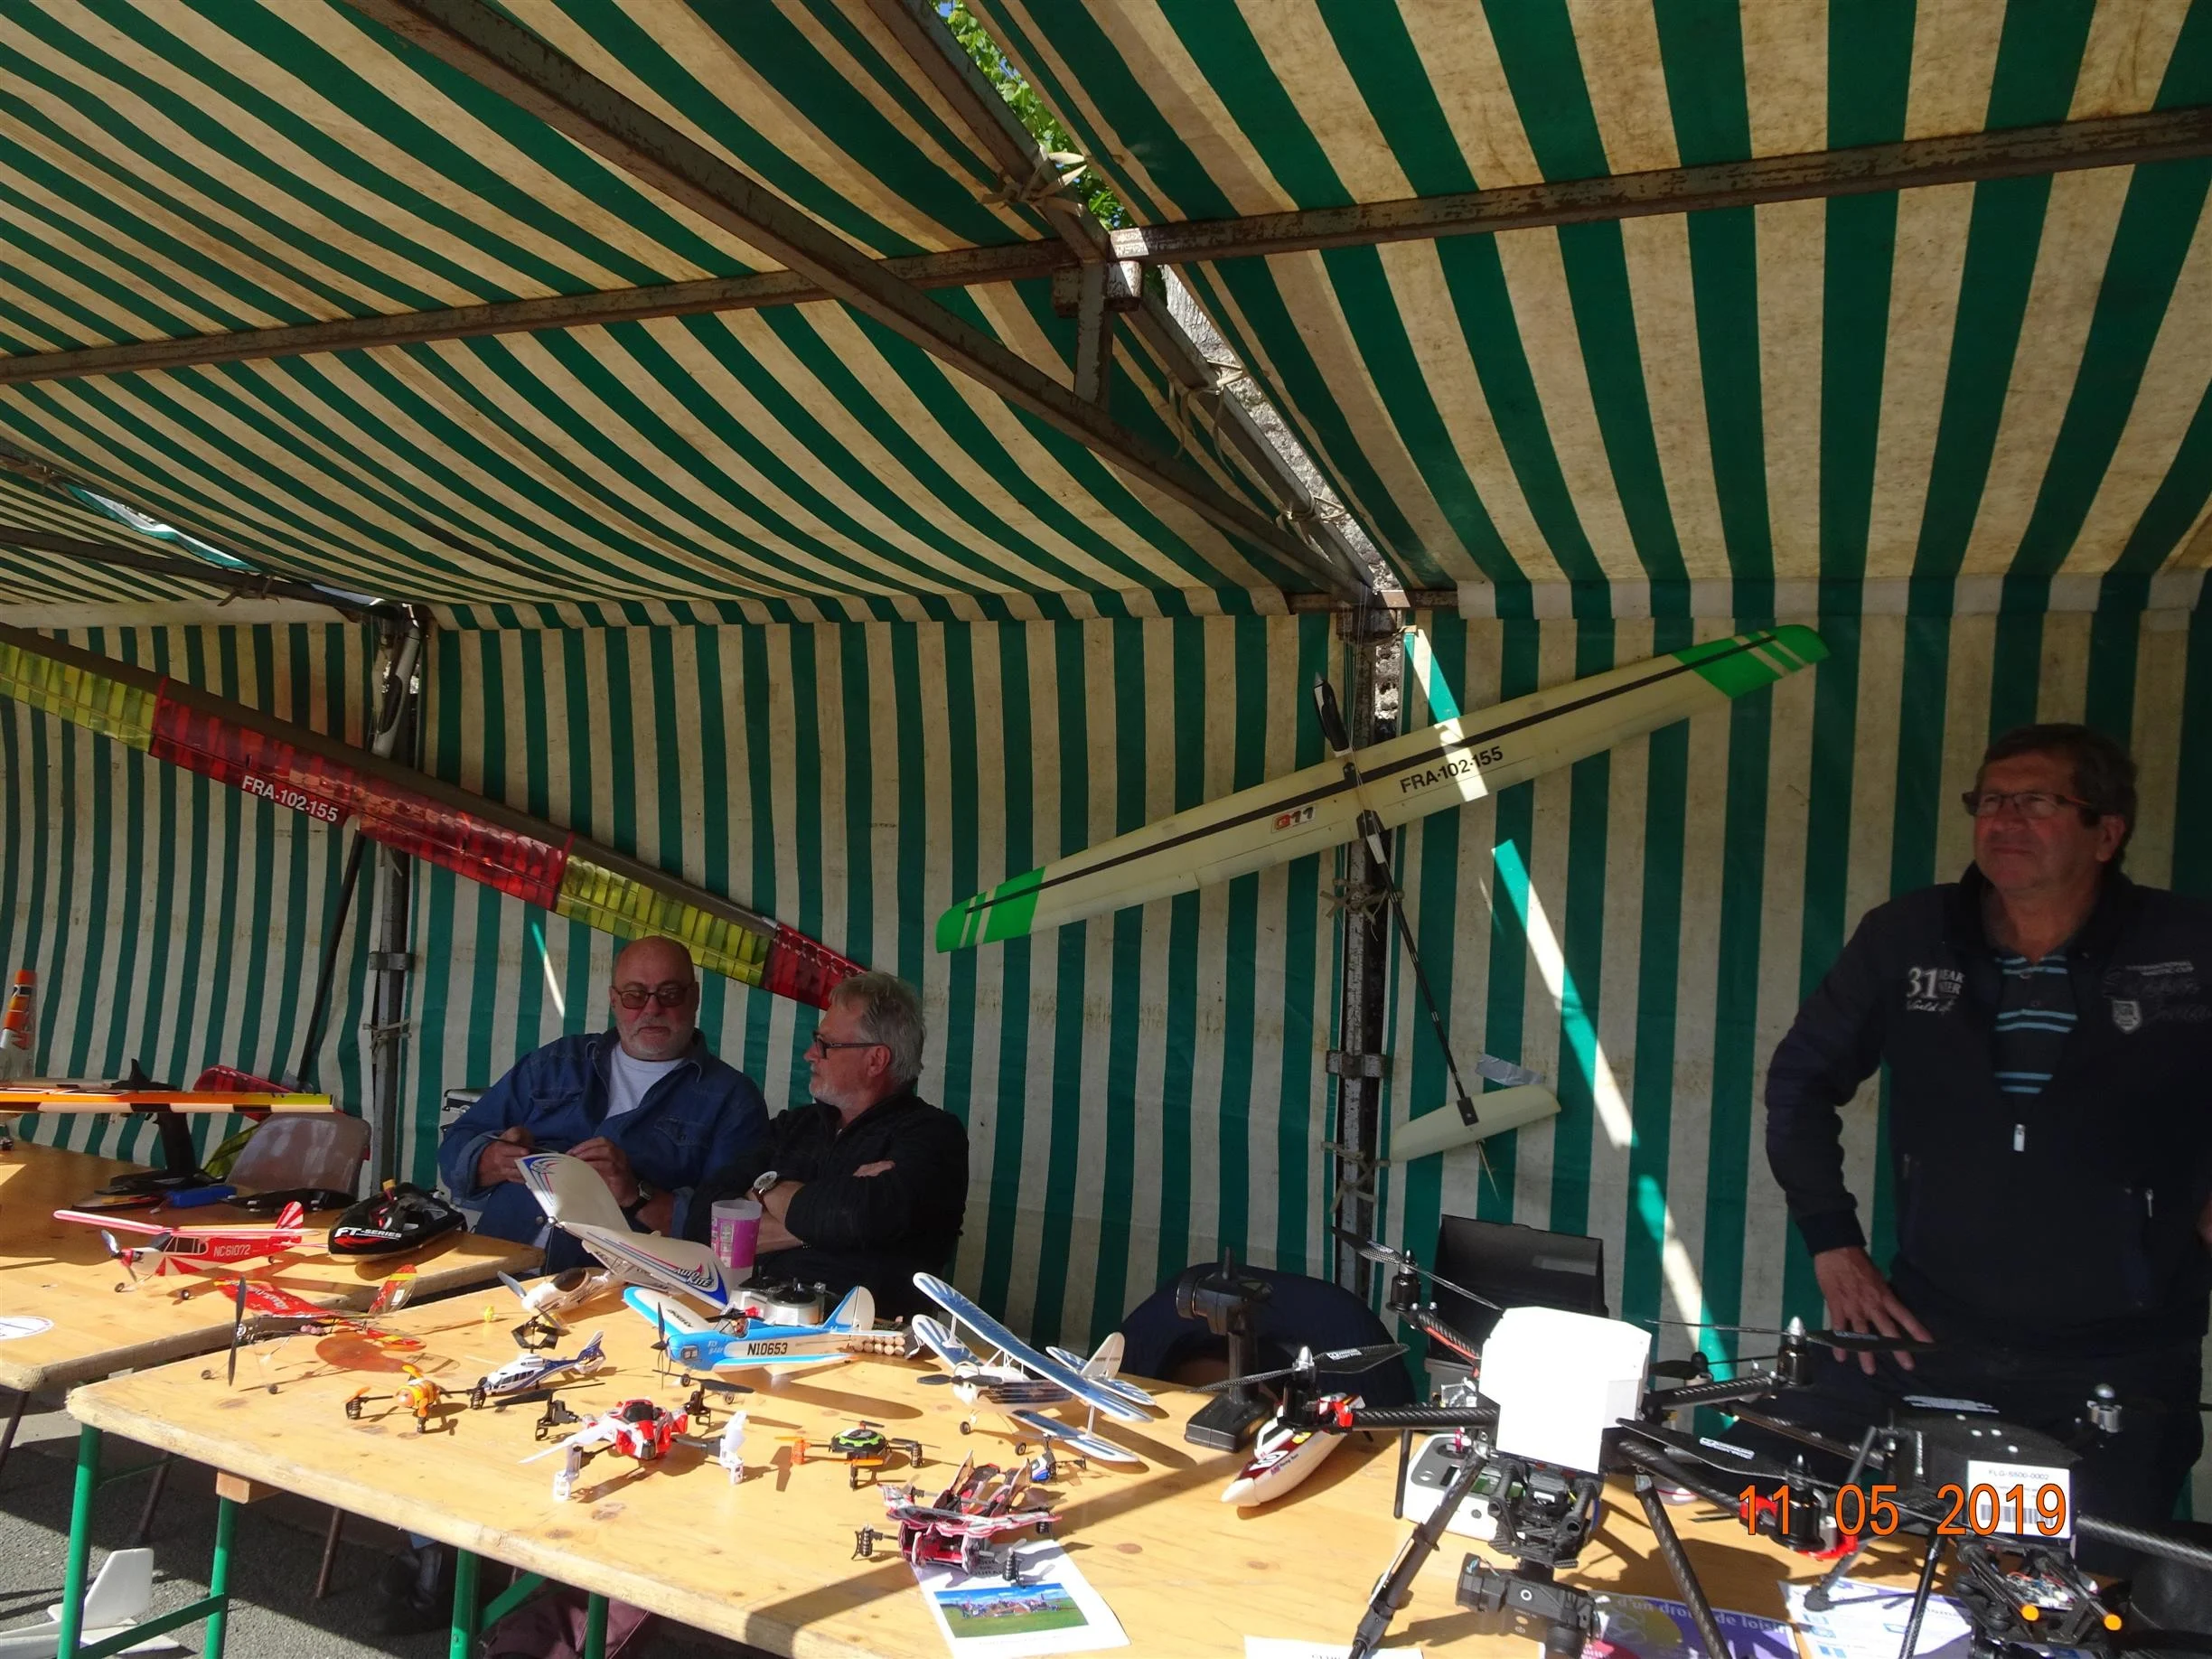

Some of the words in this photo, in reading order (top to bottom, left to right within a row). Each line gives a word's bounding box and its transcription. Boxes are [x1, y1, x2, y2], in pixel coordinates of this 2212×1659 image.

[1906, 967, 1938, 999] 31
[747, 1342, 788, 1356] N10653
[1715, 1613, 1736, 1626] de
